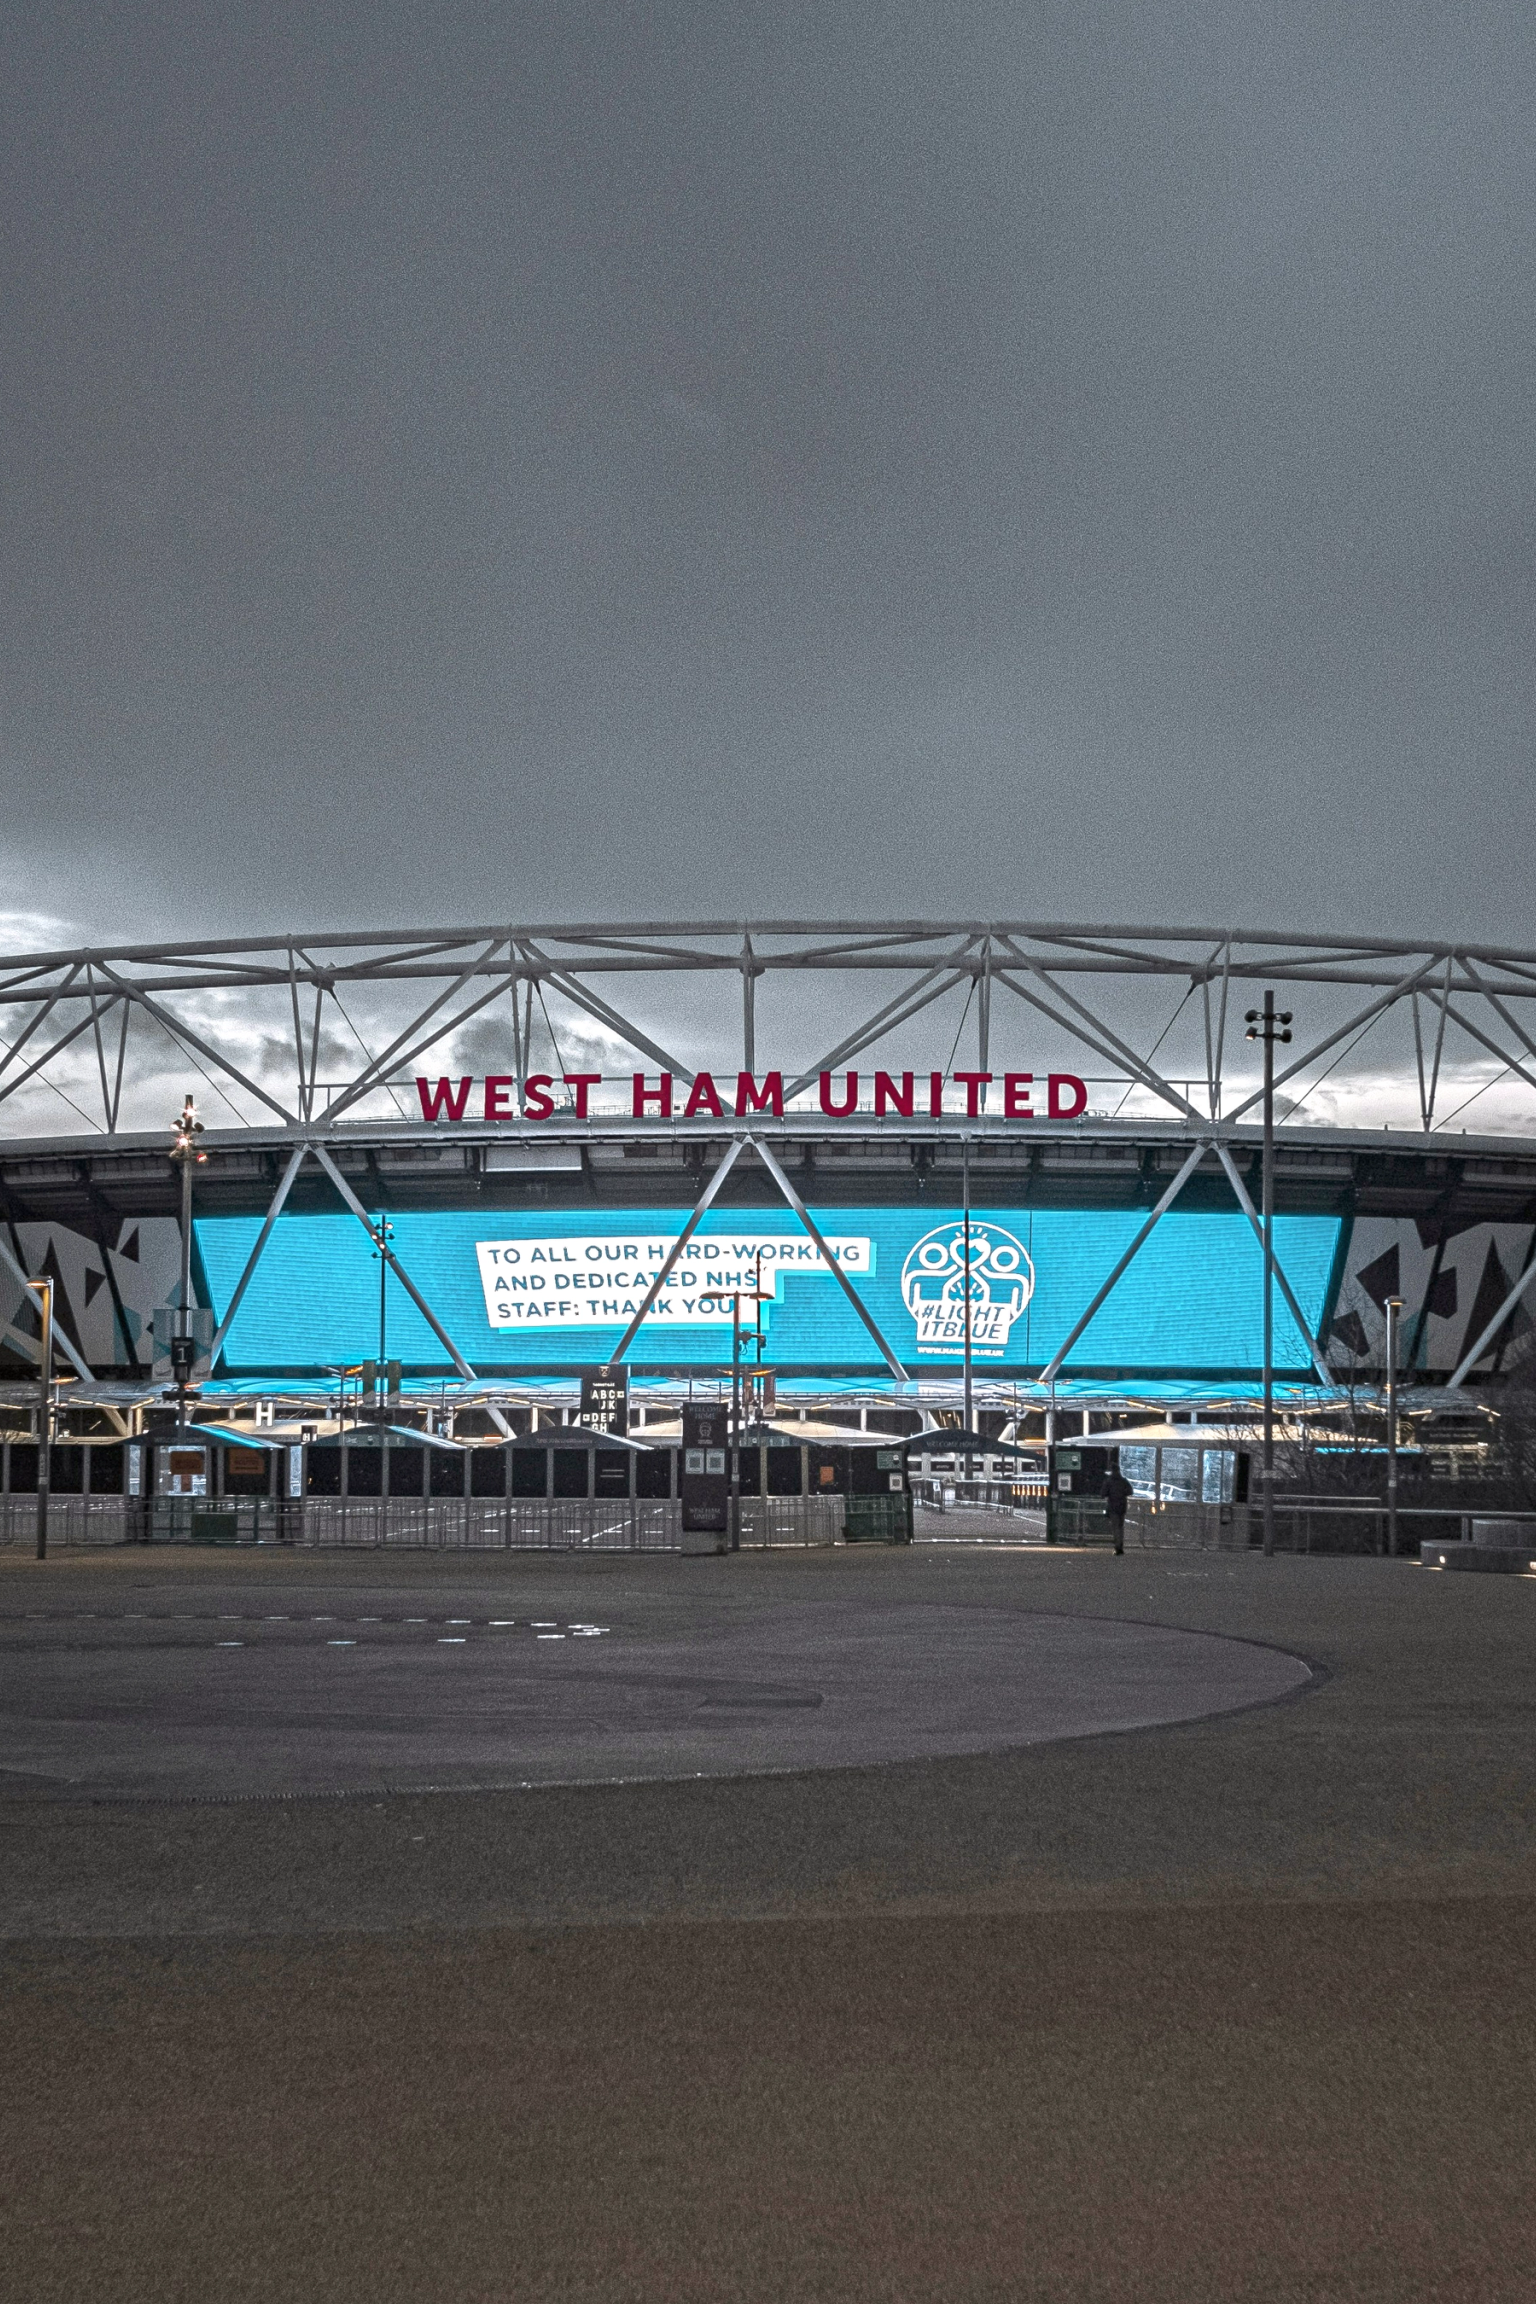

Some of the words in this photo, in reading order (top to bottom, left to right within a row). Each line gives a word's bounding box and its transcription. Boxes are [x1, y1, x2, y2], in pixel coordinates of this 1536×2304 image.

[416, 1073, 602, 1121] WEST
[632, 1071, 784, 1118] HAM
[818, 1071, 1088, 1119] UNITED
[488, 1248, 521, 1264] TO
[531, 1246, 577, 1263] ALL
[585, 1244, 639, 1261] OUR
[494, 1274, 546, 1292] AND
[554, 1271, 698, 1290] DEDICATED
[706, 1271, 758, 1287] NHS
[497, 1301, 580, 1319] STAFF:
[682, 1298, 735, 1315] YOU
[178, 1346, 187, 1363] 1
[255, 1401, 274, 1427] H
